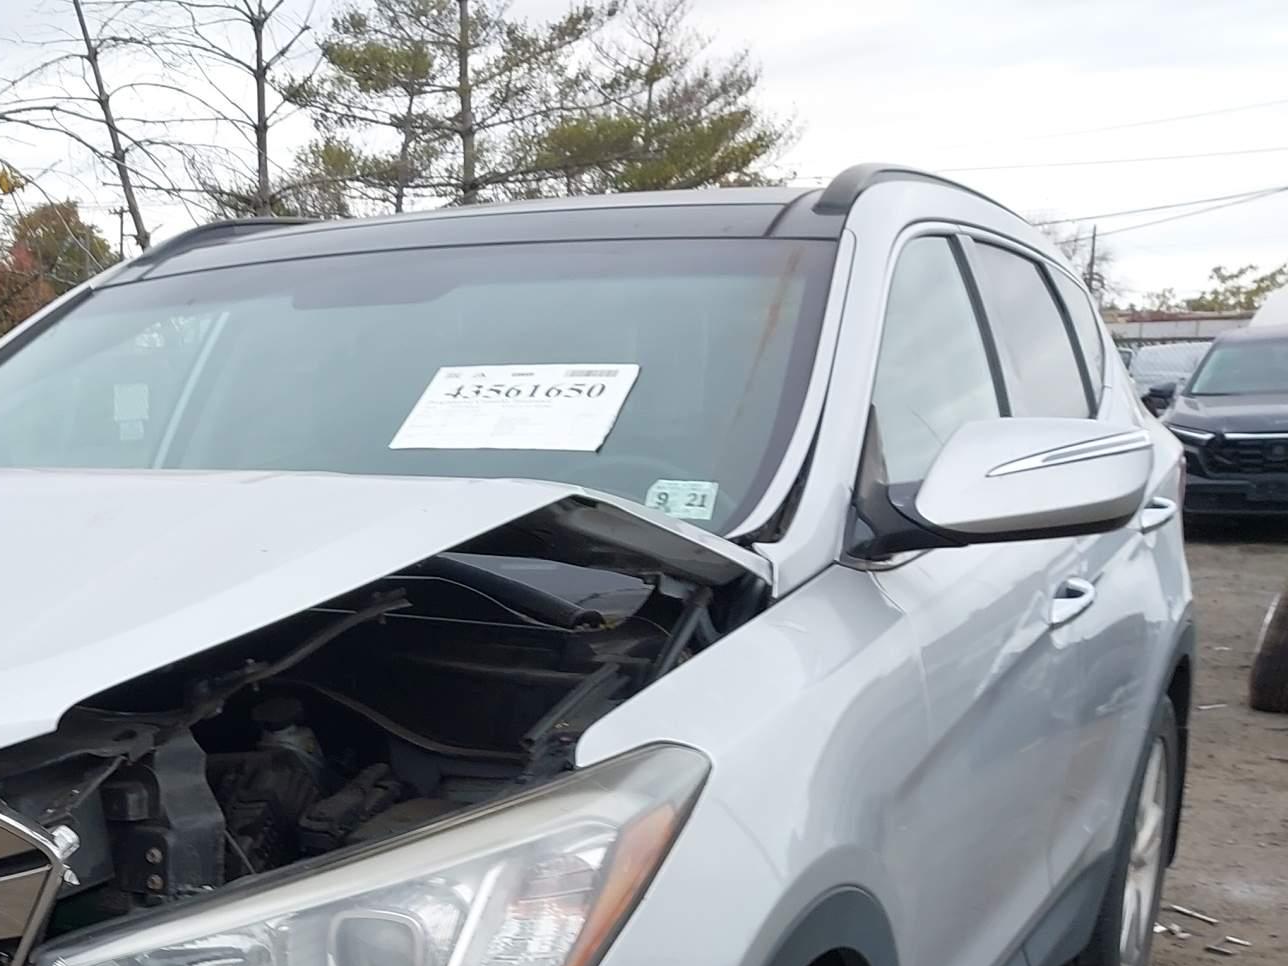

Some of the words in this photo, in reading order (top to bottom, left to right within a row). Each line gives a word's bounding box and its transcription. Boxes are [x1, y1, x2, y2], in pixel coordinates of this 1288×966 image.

[444, 383, 606, 399] 43561650
[655, 492, 669, 505] 9
[685, 493, 707, 507] 21
